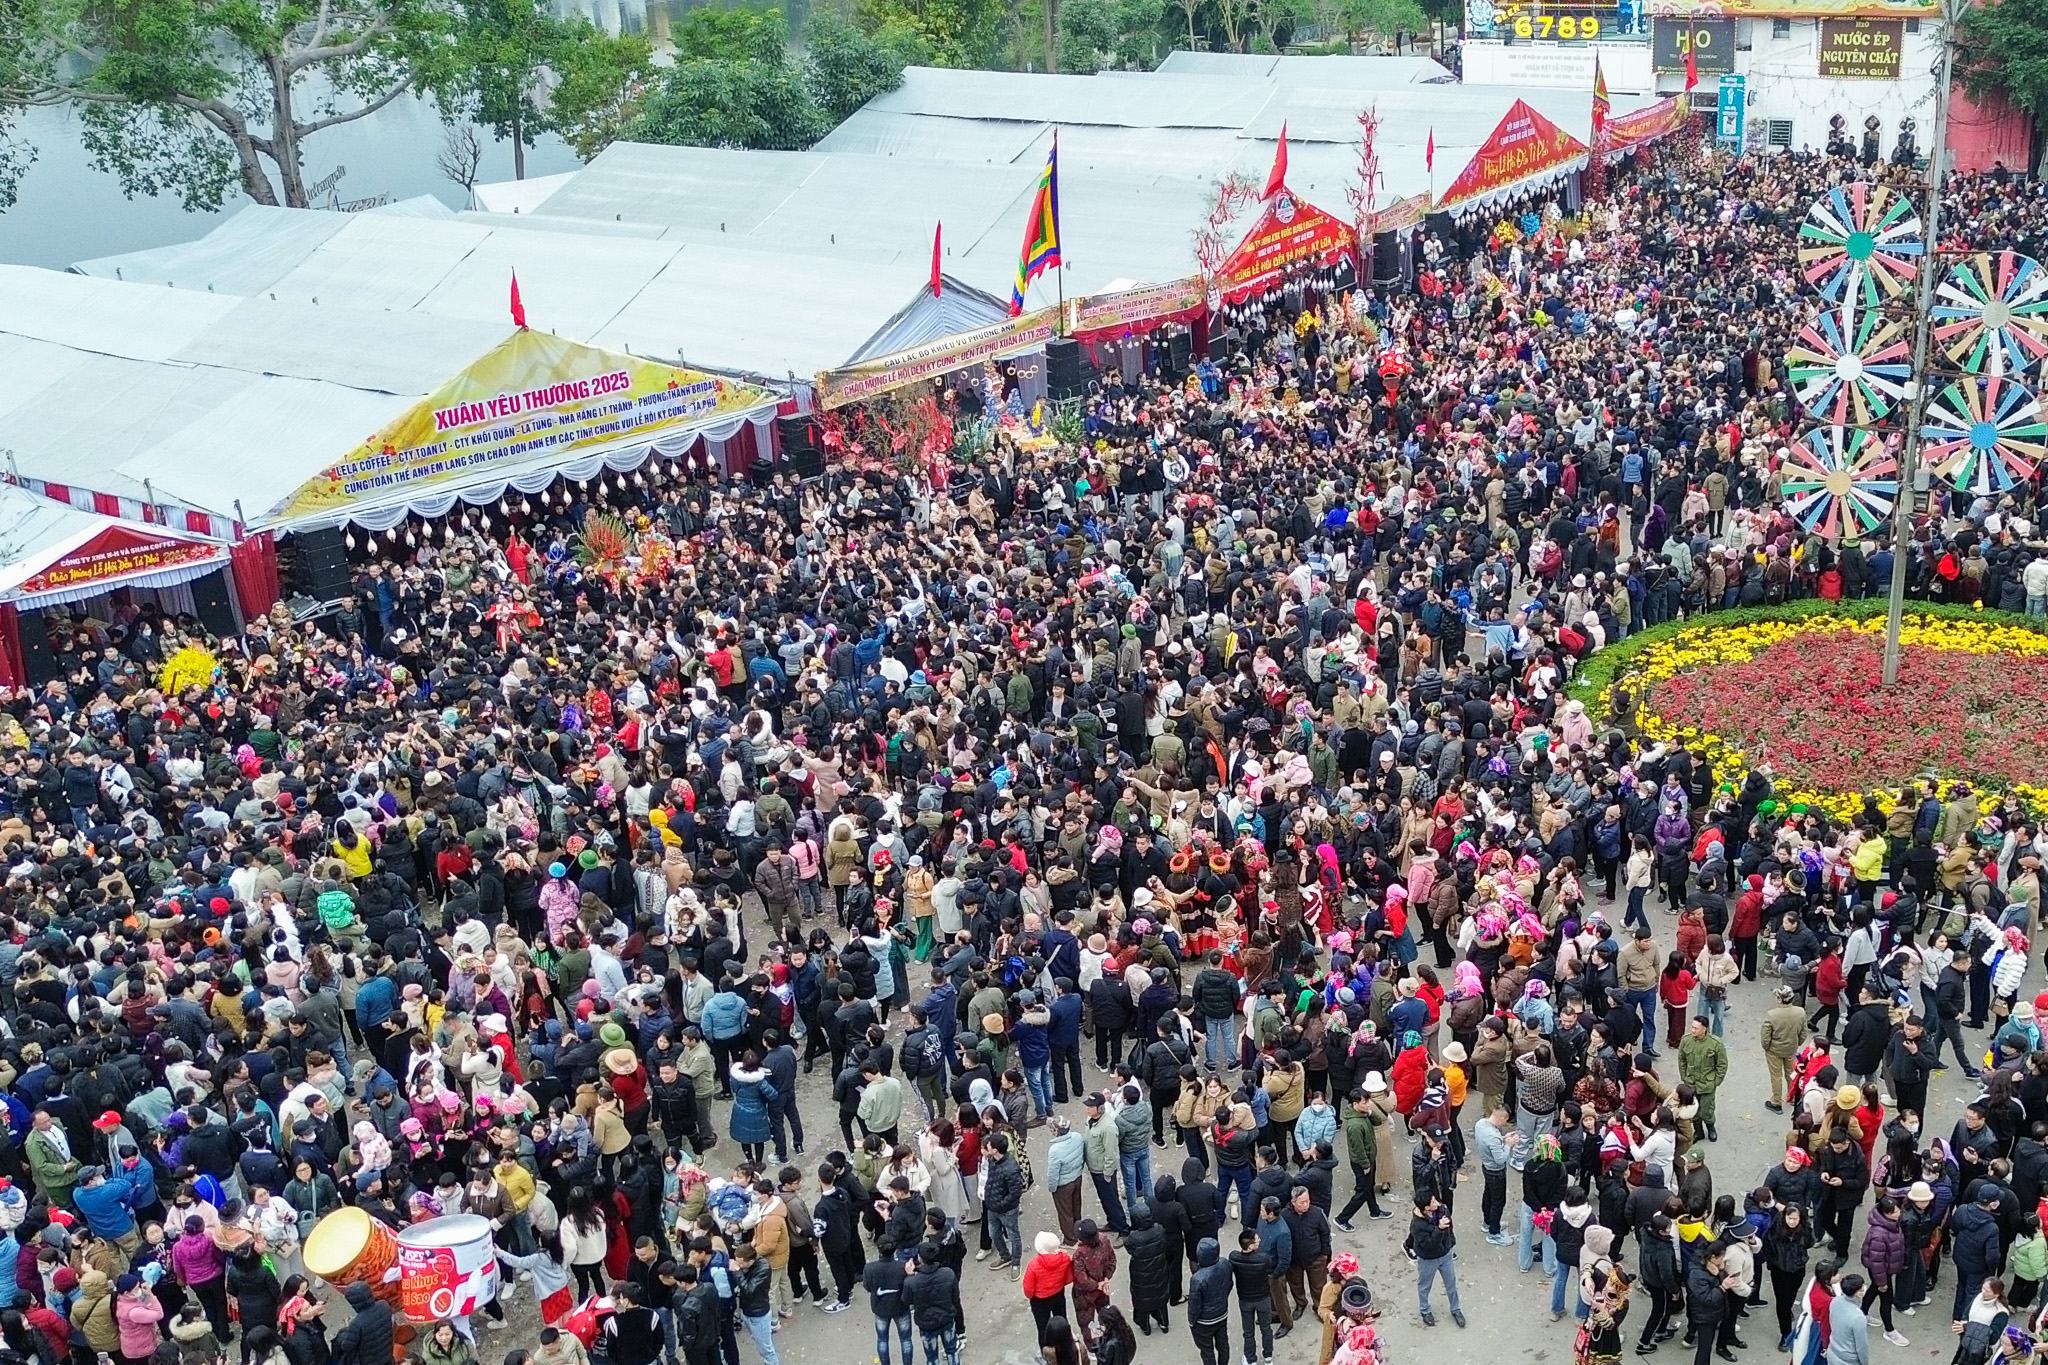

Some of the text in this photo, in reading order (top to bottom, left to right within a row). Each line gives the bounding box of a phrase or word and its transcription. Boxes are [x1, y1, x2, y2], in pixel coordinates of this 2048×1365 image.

[1515, 16, 1599, 38] 6789
[1833, 31, 1890, 46] NƯỚC ÉP
[1823, 47, 1898, 63] NGUYÊN CHẤT
[1829, 65, 1889, 76] TRÀ HOA QUẢ
[435, 371, 630, 430] XUÂN YÊU THƯƠNG 2025
[336, 464, 358, 477] LELA
[360, 455, 392, 472] COFFEE
[398, 450, 414, 463] CTY
[455, 435, 470, 449] CTY
[692, 380, 717, 394] BRIDAL
[412, 466, 429, 479] ANH
[431, 462, 444, 474] EM
[445, 456, 467, 472] LẠNG
[468, 451, 485, 465] SƠN
[528, 438, 544, 451] ANH
[545, 435, 557, 447] EM
[595, 421, 620, 436] CHUNG
[621, 417, 634, 429] VUI
[644, 410, 657, 425] HỘI
[60, 557, 80, 567] CÔNG
[81, 555, 91, 564] TY
[120, 546, 130, 555] VÀ
[150, 540, 177, 550] COFFEE
[411, 1274, 439, 1290] Nhục
[411, 1292, 430, 1306] Sao
